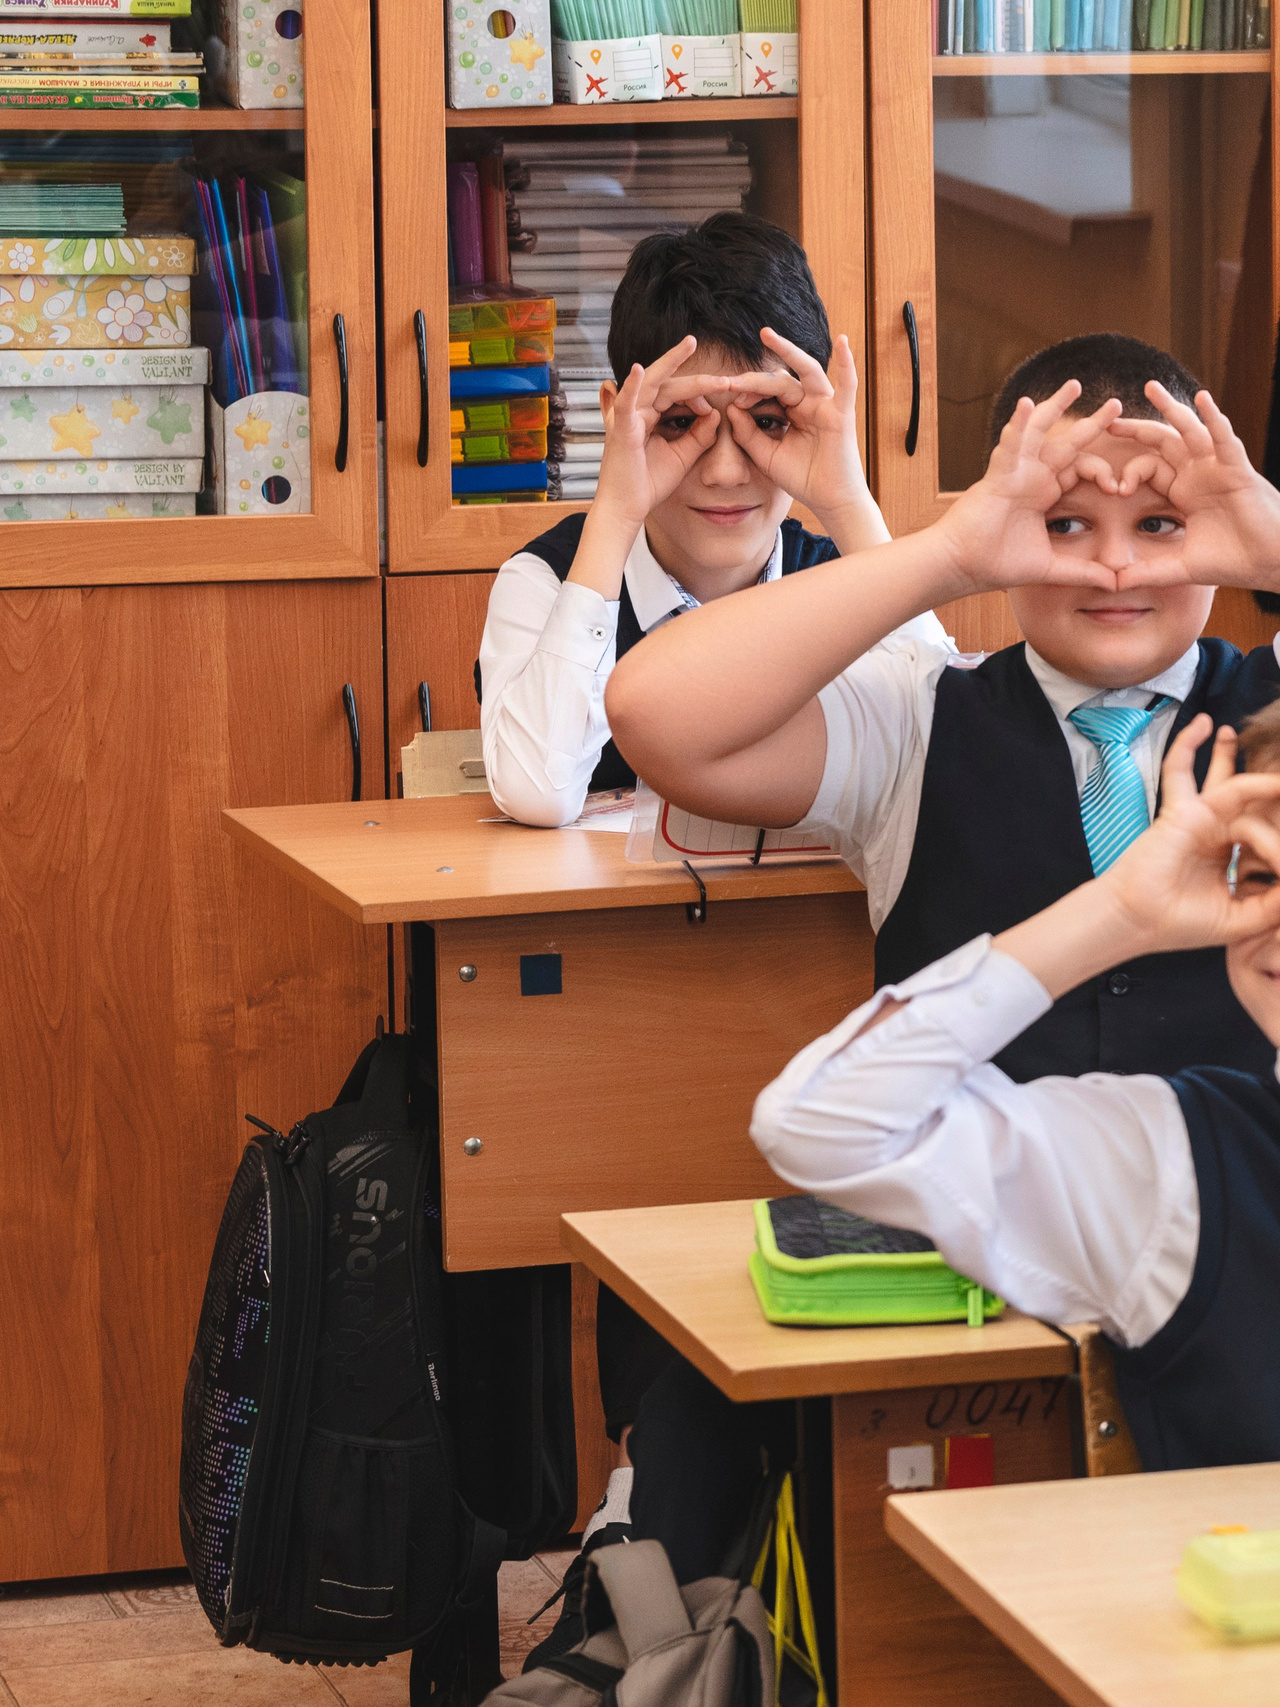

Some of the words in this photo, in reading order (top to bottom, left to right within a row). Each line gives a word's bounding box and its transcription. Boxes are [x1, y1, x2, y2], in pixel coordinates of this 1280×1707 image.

[38, 79, 80, 87] МАЛЫШОМ
[623, 83, 647, 92] Россия
[702, 79, 728, 88] Россия
[9, 95, 27, 105] НА
[27, 95, 70, 105] СКАЗКИ
[141, 355, 177, 366] DESIGN
[180, 355, 193, 366] BY
[141, 366, 193, 379] VALIANT
[133, 463, 169, 474] DESIGN
[172, 463, 186, 474] BY
[134, 474, 186, 487] VALIANT
